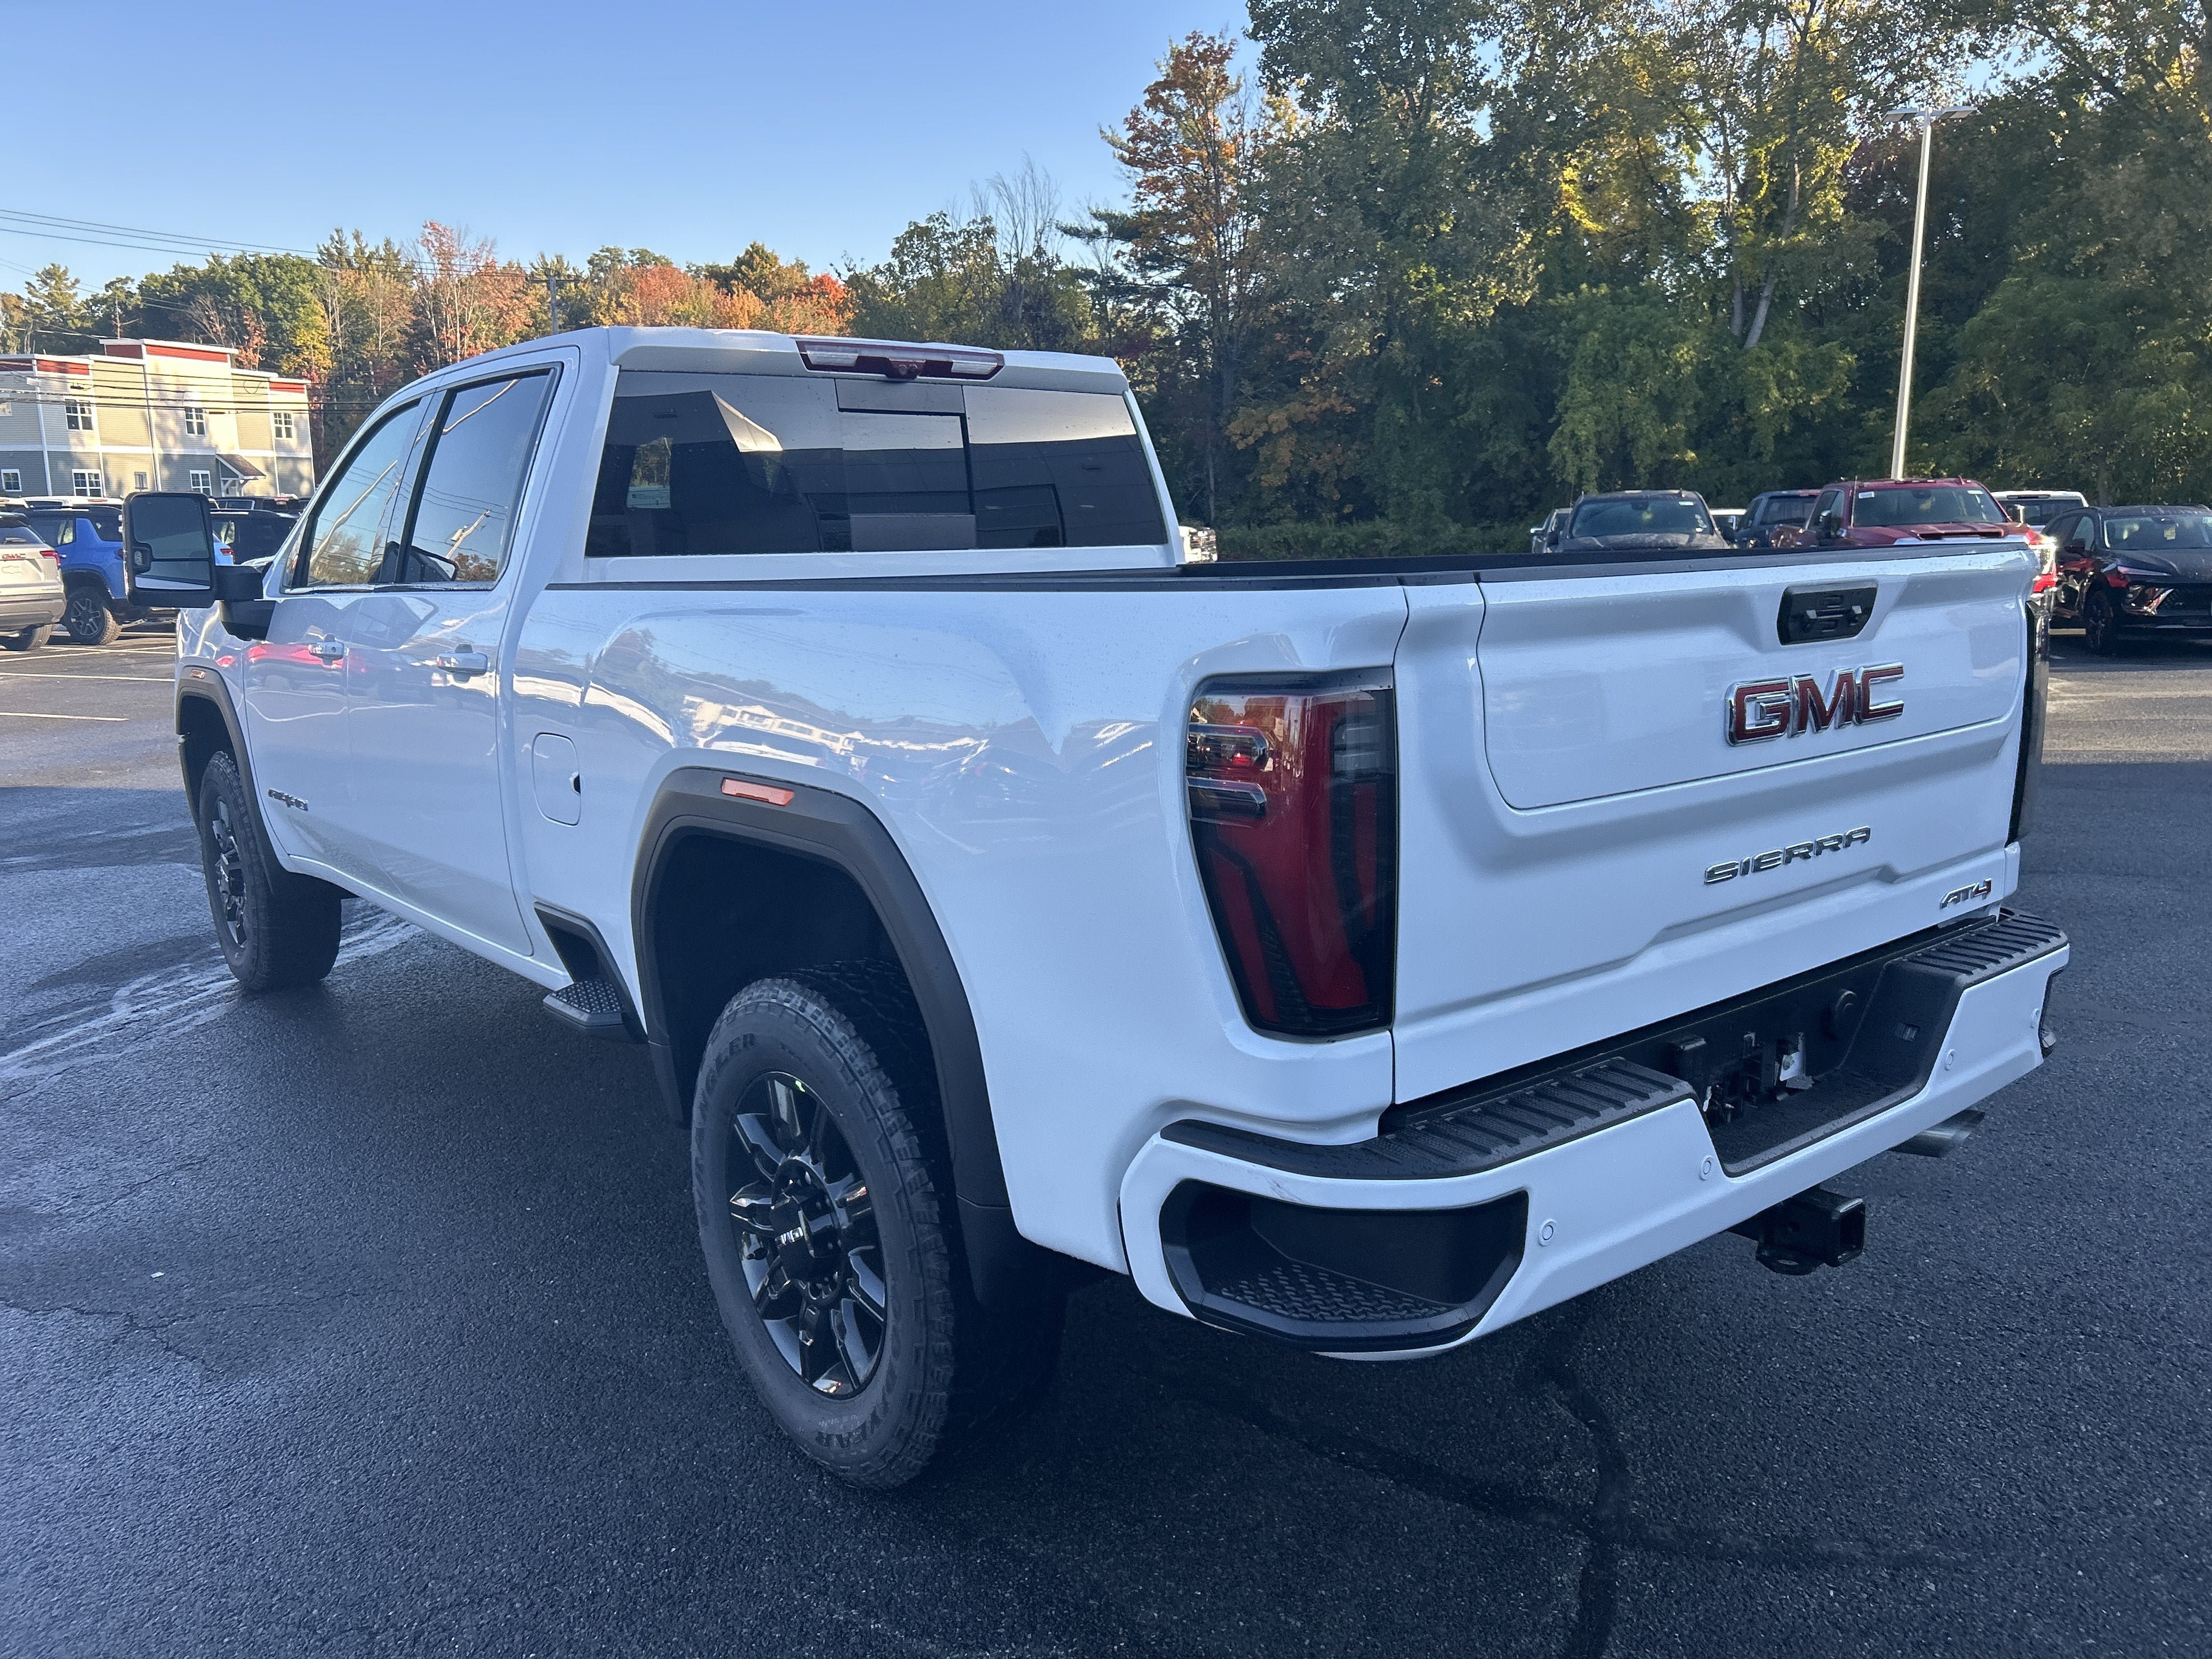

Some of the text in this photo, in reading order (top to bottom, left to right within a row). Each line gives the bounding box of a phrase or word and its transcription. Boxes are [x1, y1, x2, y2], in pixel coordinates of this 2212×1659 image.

[1725, 662, 1905, 747] GMC
[1704, 825, 1871, 885] SIERRA
[1939, 878, 1992, 910] AT4
